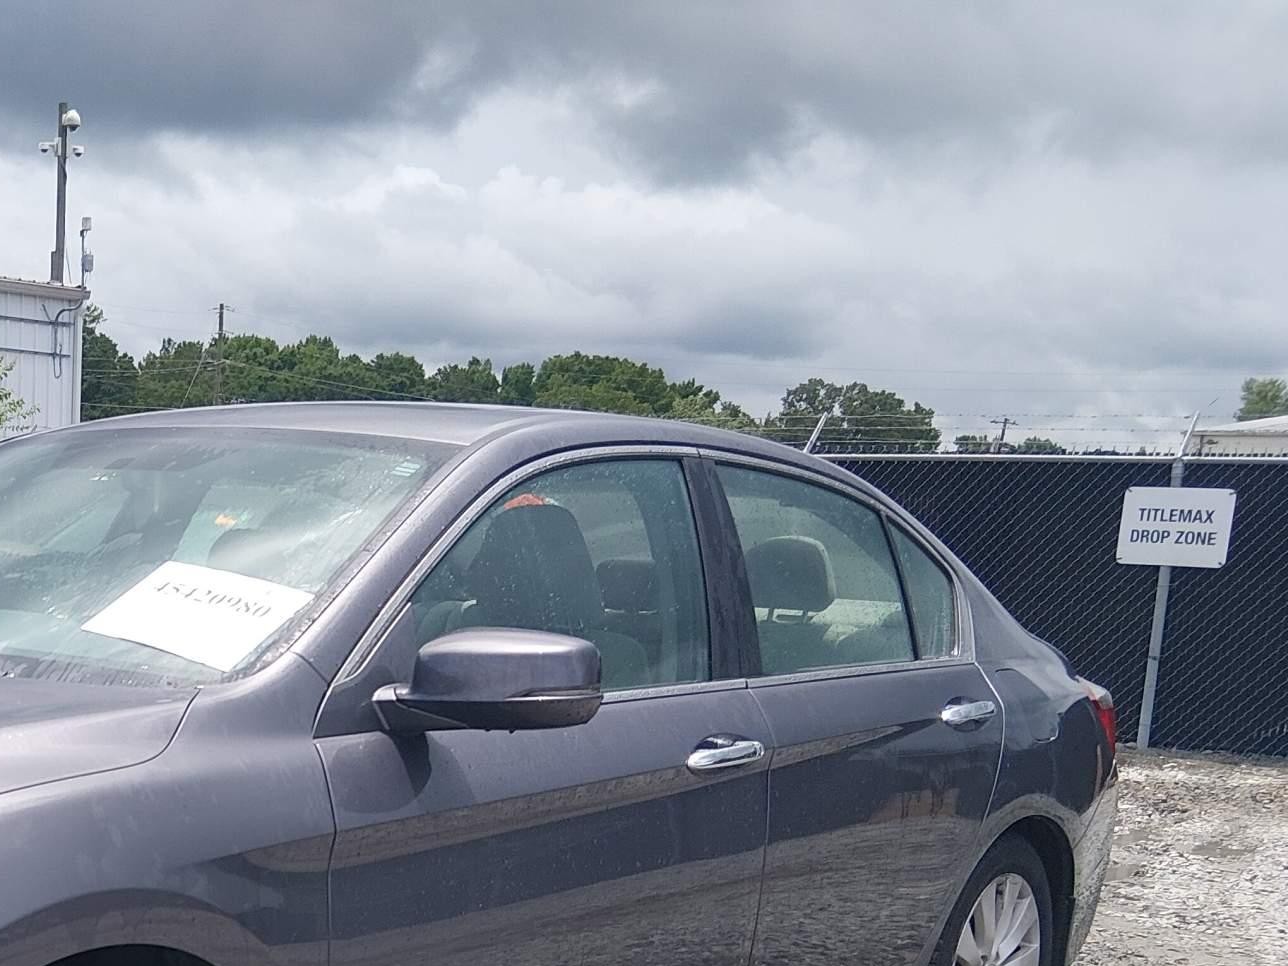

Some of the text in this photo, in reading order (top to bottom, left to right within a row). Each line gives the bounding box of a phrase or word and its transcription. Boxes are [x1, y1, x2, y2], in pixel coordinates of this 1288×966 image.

[1138, 508, 1214, 523] TITLEMAX
[1130, 529, 1217, 546] DROP ZONE
[154, 581, 272, 617] 45420980
